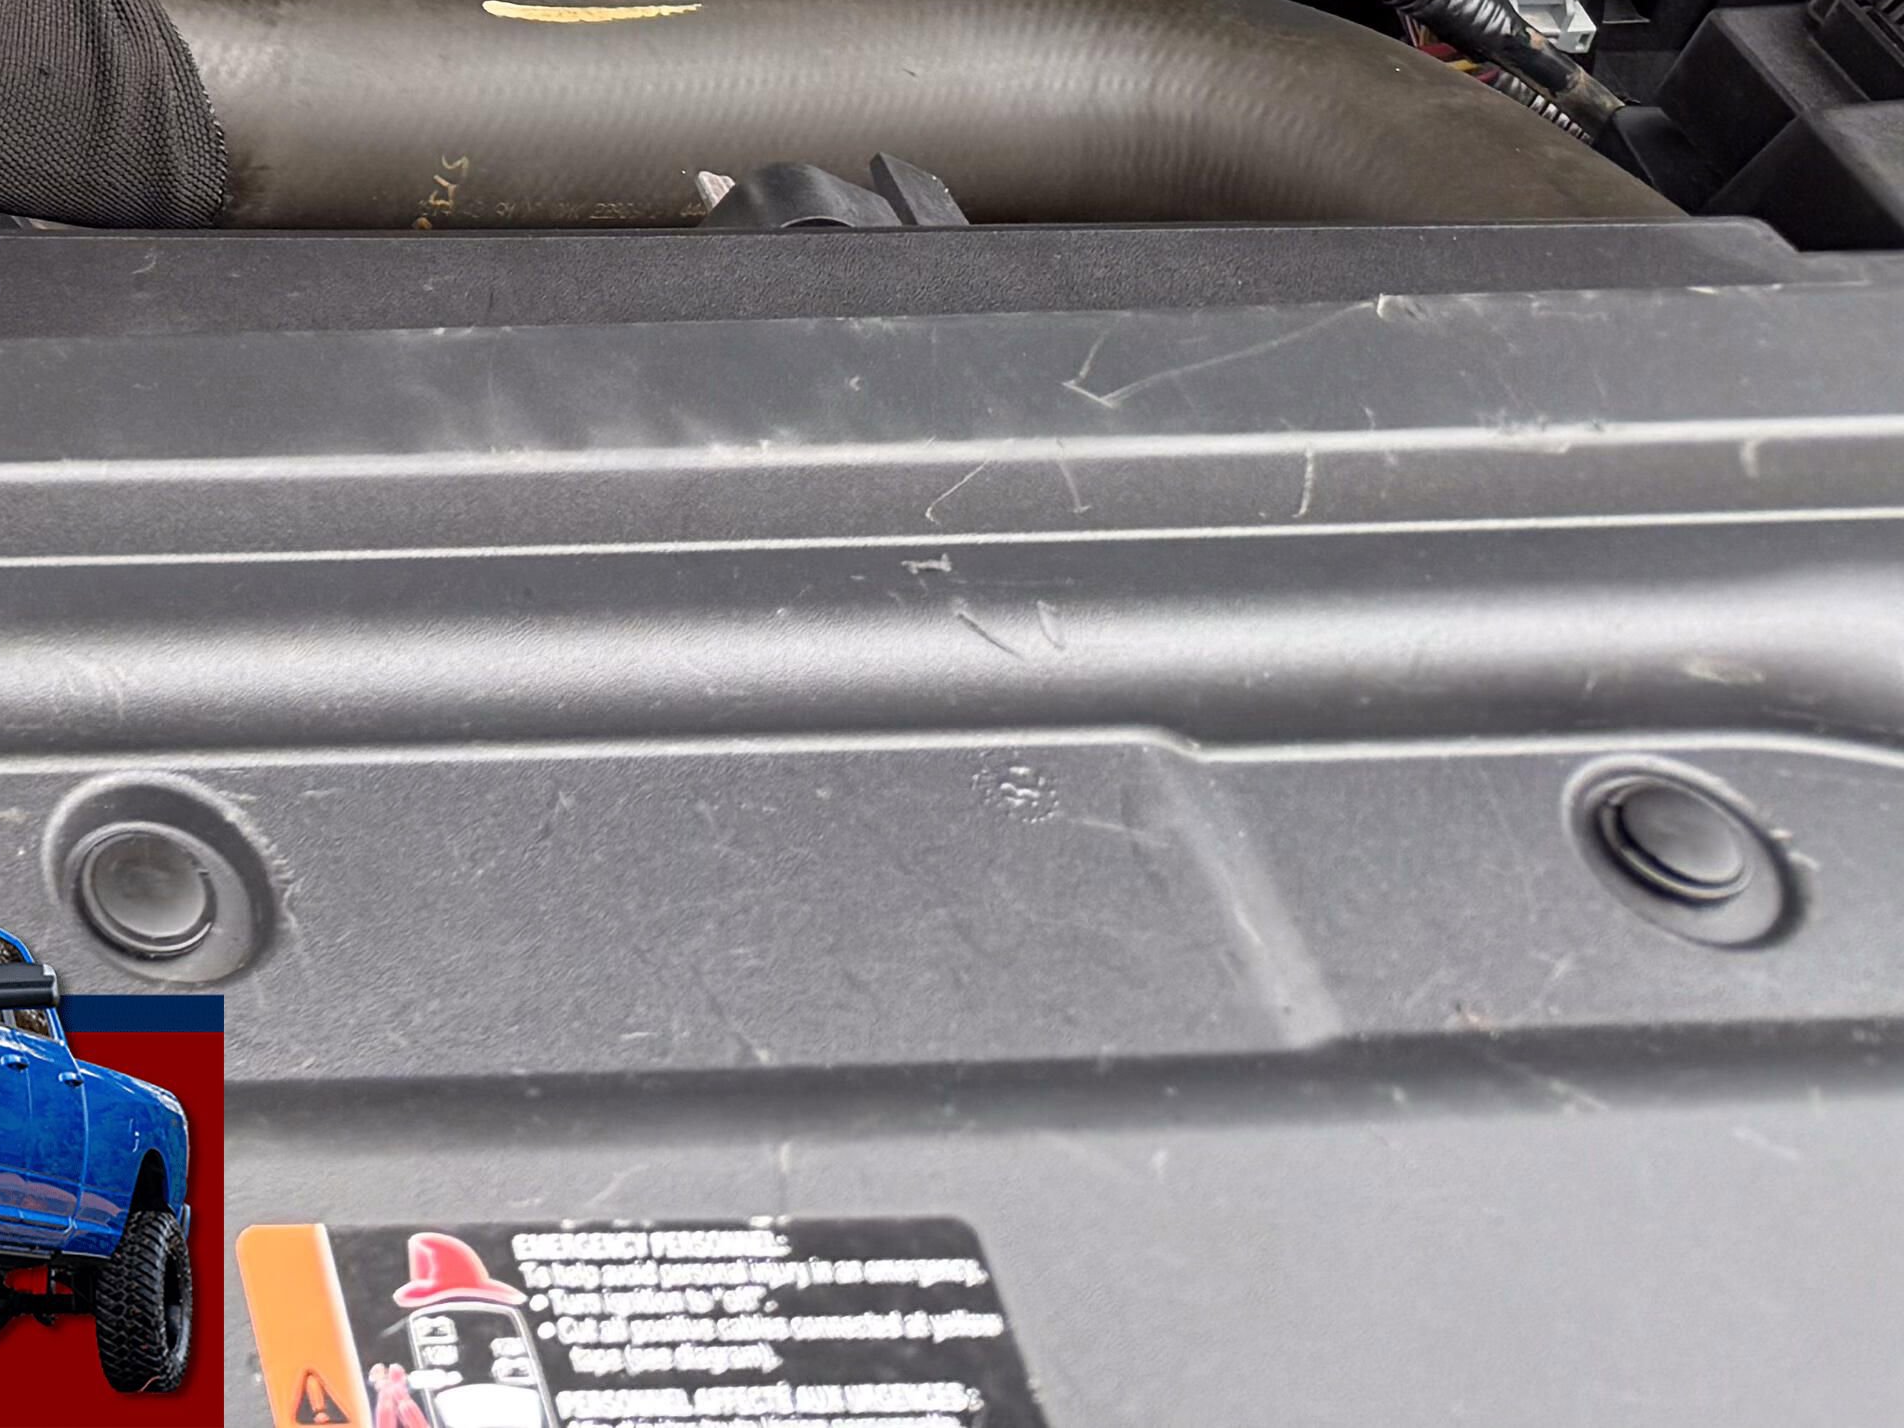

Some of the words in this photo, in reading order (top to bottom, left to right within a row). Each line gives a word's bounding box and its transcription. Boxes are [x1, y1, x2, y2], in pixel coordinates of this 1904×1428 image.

[512, 1233, 648, 1260] EMERGENCY
[519, 1262, 551, 1286] To
[601, 1260, 659, 1286] avoid
[659, 1260, 748, 1288] personal
[748, 1259, 811, 1289] injury
[549, 1289, 601, 1314] Turn
[557, 1316, 598, 1344] Cut
